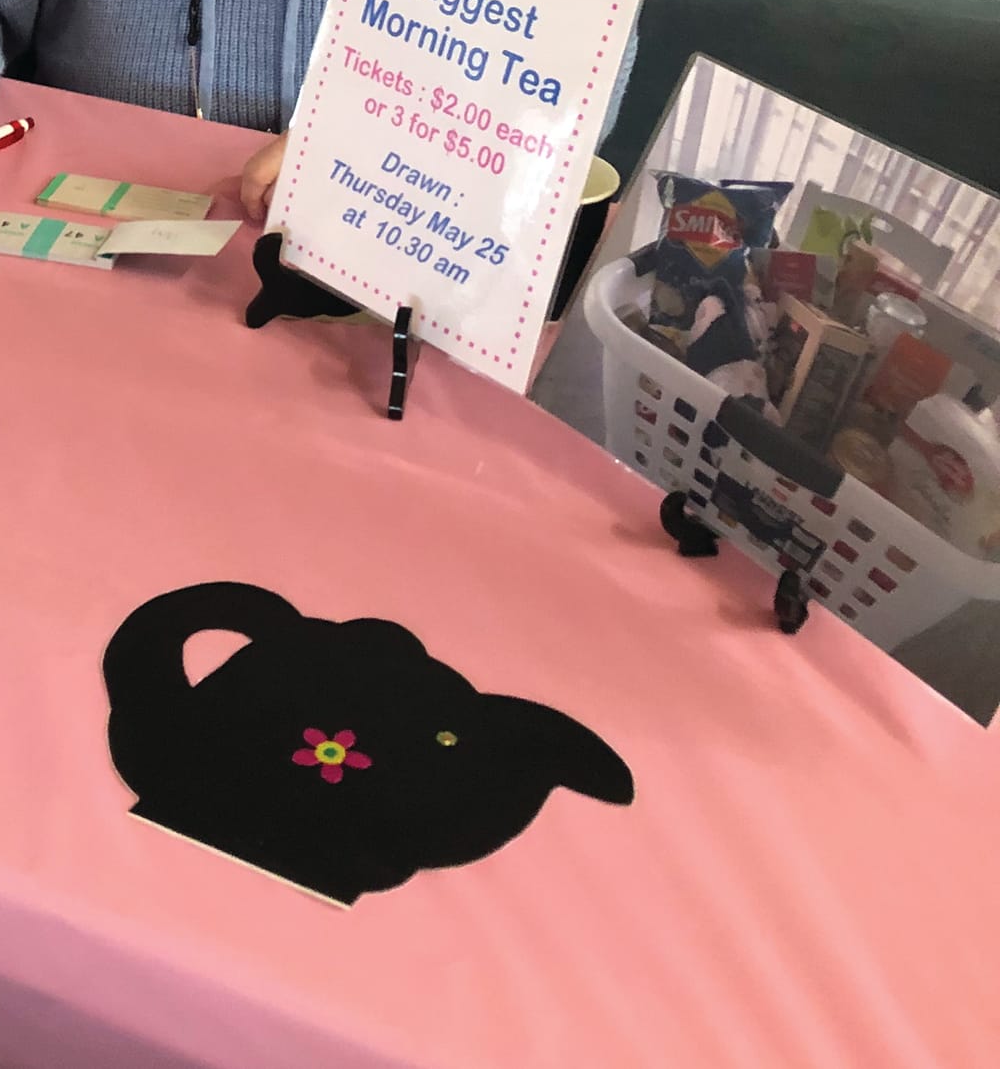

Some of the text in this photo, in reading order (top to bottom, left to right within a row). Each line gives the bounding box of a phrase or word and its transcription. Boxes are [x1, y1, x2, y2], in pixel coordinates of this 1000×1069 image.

[344, 45, 414, 96] Tickets
[430, 85, 492, 131] $2.00
[495, 122, 554, 159] each
[501, 49, 561, 107] Tea
[364, 98, 505, 175] or 3 for $5.00
[330, 158, 510, 266] Thursday May 25
[380, 151, 452, 202] Drawn
[342, 207, 471, 285] at 10.30 am
